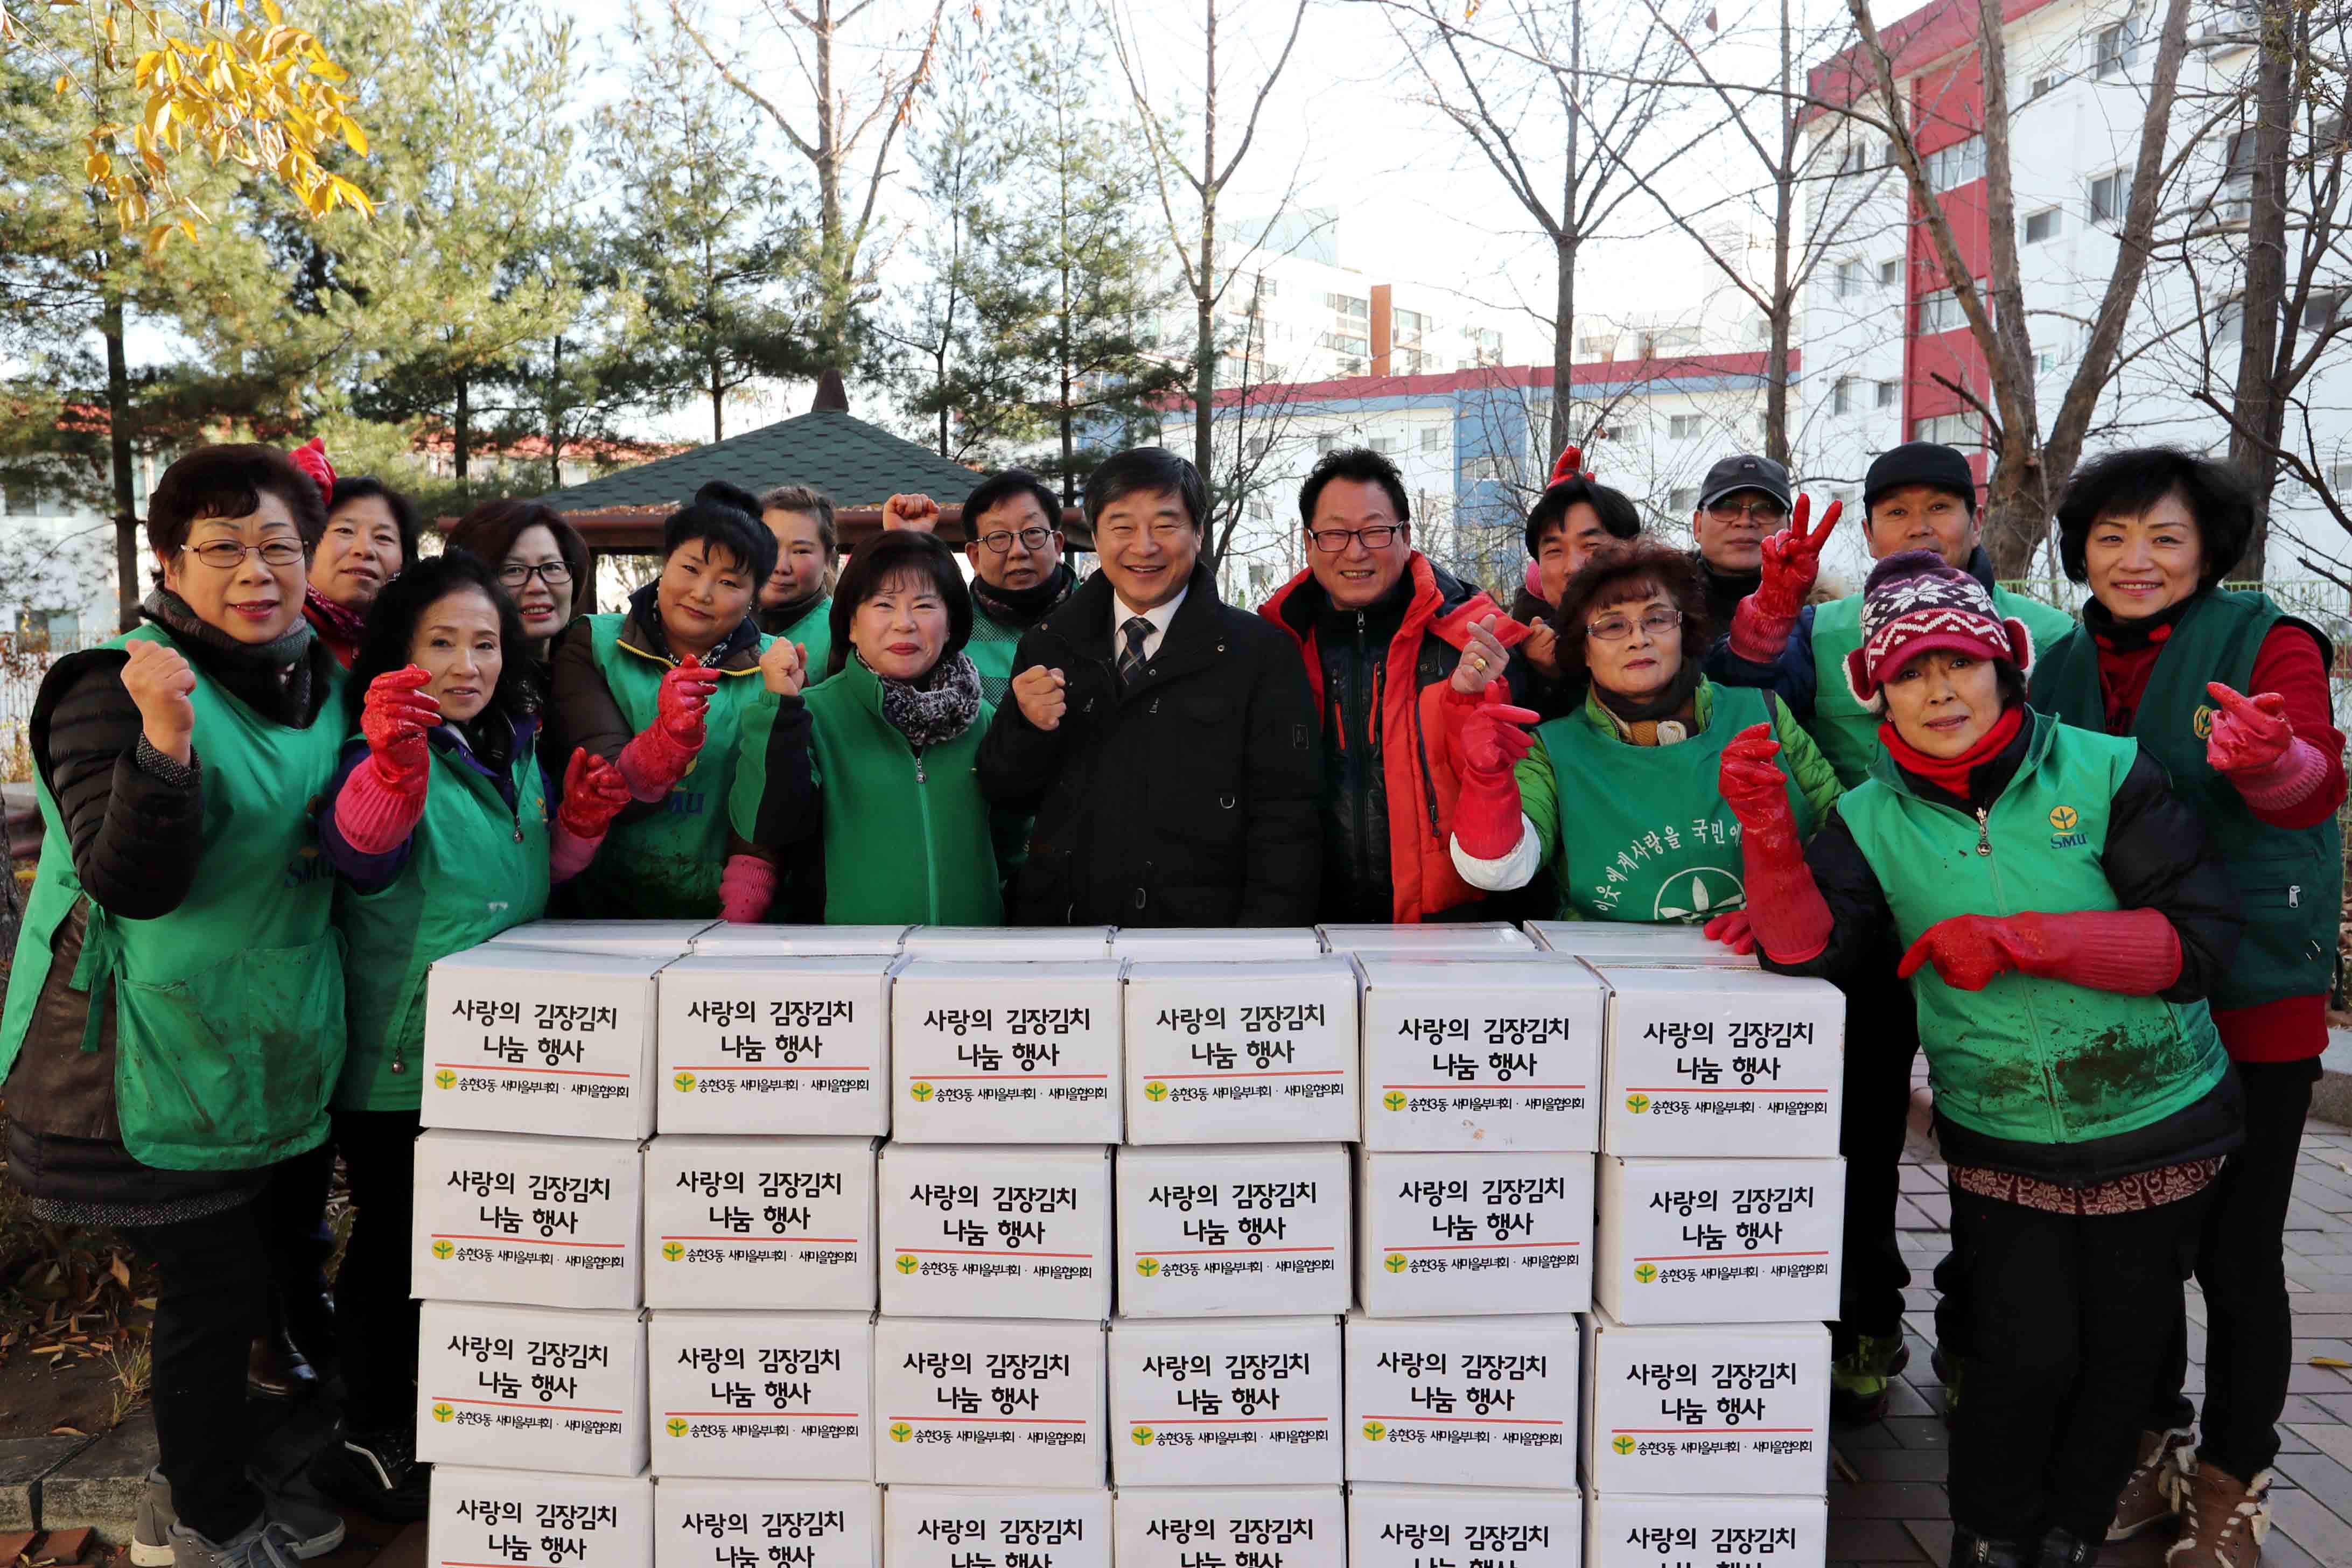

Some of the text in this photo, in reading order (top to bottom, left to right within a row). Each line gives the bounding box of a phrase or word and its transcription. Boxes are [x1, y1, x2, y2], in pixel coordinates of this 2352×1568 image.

[2051, 833, 2087, 849] SMU
[452, 999, 616, 1032] 사랑의 김장김치
[688, 1000, 852, 1027] 사랑의 김장김치
[924, 1008, 1089, 1035] 사랑의 김장김치
[1157, 1004, 1324, 1035] 사랑의 김장김치
[1398, 1018, 1569, 1045] 사랑의 김장김치
[1643, 1023, 1813, 1049] 사랑의 김장김치
[484, 1036, 584, 1066] 나눔 행사
[722, 1034, 822, 1063] 나눔 행사
[958, 1043, 1060, 1071] 나눔 행사
[1192, 1040, 1294, 1069] 나눔 행사
[1433, 1053, 1537, 1081] 나눔 행사
[1677, 1056, 1781, 1085] 나눔 행사
[459, 1078, 628, 1098] 송현3동 새마을부녀회 새마을협의회
[698, 1079, 869, 1093] 송현3동 새마을부녀회 새마을협의회
[935, 1087, 1107, 1102] 송현3동 새마을부녀회 새마을협의회
[1170, 1083, 1343, 1102] 송현3동 새마을부녀회 새마을협의회
[1409, 1097, 1584, 1112] 송현3동 새마을부녀회 새마을협의회
[1651, 1101, 1826, 1115] 송현3동 새마을부녀회 새마을협의회
[447, 1171, 610, 1203] 사랑의 김장김치
[676, 1171, 841, 1199] 사랑의 김장김치
[1149, 1182, 1316, 1212] 사랑의 김장김치
[1399, 1178, 1564, 1207] 사랑의 김장김치
[910, 1185, 1076, 1213] 사랑의 김장김치
[1650, 1187, 1813, 1216] 사랑의 김장김치
[480, 1206, 578, 1237] 나눔 행사
[710, 1206, 810, 1234] 나눔 행사
[944, 1219, 1045, 1248] 나눔 행사
[1184, 1217, 1286, 1245] 나눔 행사
[1433, 1213, 1534, 1241] 나눔 행사
[1683, 1222, 1782, 1250] 나눔 행사
[456, 1248, 624, 1269] 송현3동 새마을부녀회 새마을협의회
[687, 1249, 856, 1264] 송현3동 새마을부녀회 새마을협의회
[1161, 1259, 1334, 1277] 송현3동 새마을부녀회 새마을협의회
[1409, 1255, 1578, 1273] 송현3동 새마을부녀회 새마을협의회
[920, 1262, 1091, 1279] 송현3동 새마을부녀회 새마을협의회
[1659, 1264, 1827, 1283] 송현3동 새마을부녀회 새마을협의회
[448, 1335, 607, 1369] 사랑의 김장김치
[678, 1348, 839, 1374] 사랑의 김장김치
[903, 1353, 1068, 1380] 사랑의 김장김치
[1143, 1353, 1309, 1381] 사랑의 김장김치
[1377, 1352, 1545, 1381] 사랑의 김장김치
[1627, 1363, 1795, 1390] 사랑의 김장김치
[479, 1371, 577, 1402] 나눔 행사
[712, 1381, 811, 1409] 나눔 행사
[938, 1387, 1039, 1415] 나눔 행사
[1178, 1388, 1279, 1415] 나눔 행사
[1412, 1387, 1515, 1415] 나눔 행사
[1662, 1397, 1765, 1425] 나눔 행사
[456, 1411, 621, 1434] 송현3동 새마을부녀회 새마을협의회
[690, 1425, 858, 1438] 송현3동 새마을부녀회 새마을협의회
[914, 1430, 1085, 1445] 송현3동 새마을부녀회 새마을협의회
[1156, 1430, 1328, 1446] 송현3동 새마을부녀회 새마을협의회
[1387, 1429, 1562, 1446] 송현3동 새마을부녀회 새마을협의회
[1637, 1440, 1812, 1455] 송현3동 새마을부녀회 새마을협의회
[457, 1500, 616, 1530] 사랑의 김장김치
[682, 1511, 844, 1538] 사랑의 김장김치
[918, 1519, 1082, 1545] 사랑의 김장김치
[1146, 1518, 1313, 1544] 사랑의 김장김치
[1381, 1523, 1548, 1552] 사랑의 김장김치
[1627, 1528, 1795, 1555] 사랑의 김장김치
[489, 1535, 587, 1564] 나눔 행사
[716, 1546, 815, 1568] 나눔 행사
